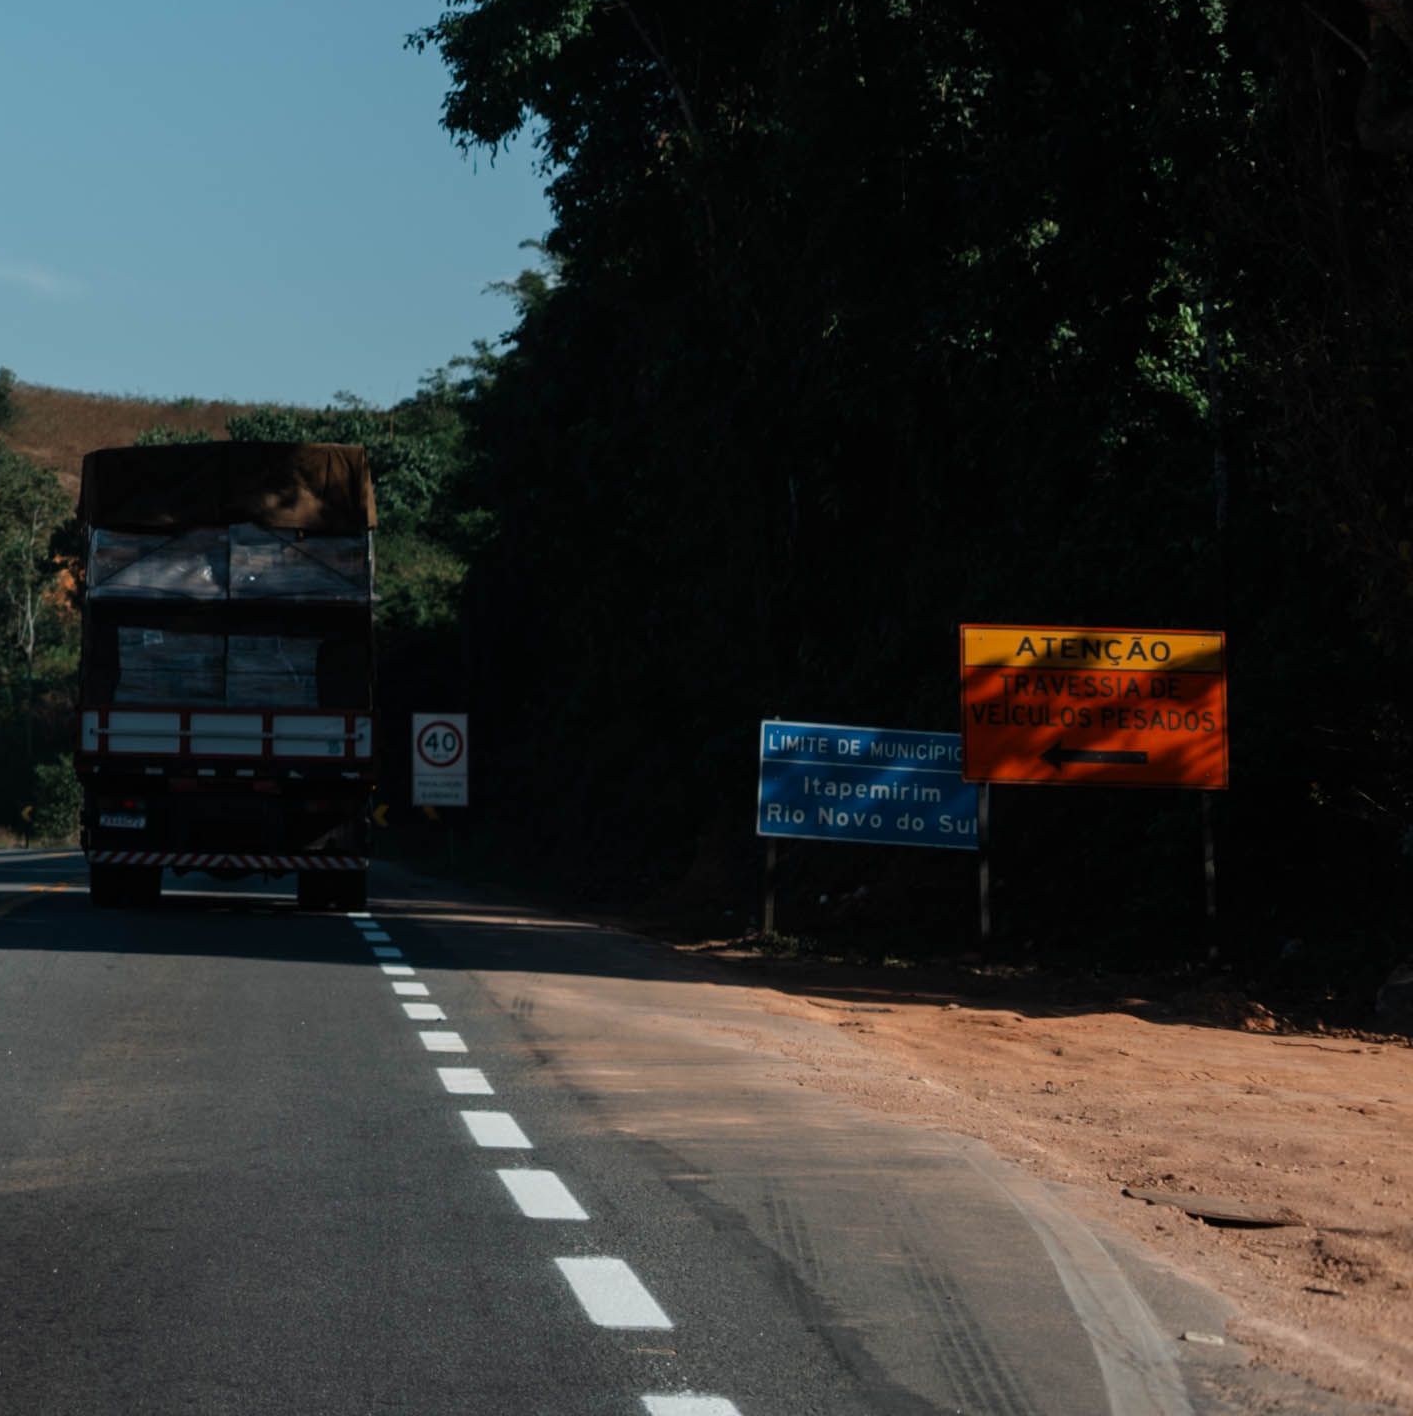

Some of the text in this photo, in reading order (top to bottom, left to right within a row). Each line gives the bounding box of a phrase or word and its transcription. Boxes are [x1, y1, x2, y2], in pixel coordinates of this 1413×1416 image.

[1015, 636, 1171, 666] ATENÇÃO
[1001, 674, 1182, 700] TRAVESSIA DE
[971, 700, 1216, 733] VEÍCULOS PESADOS
[425, 731, 456, 752] 40
[768, 733, 828, 754] LIMITE
[837, 738, 861, 756] DE
[804, 776, 941, 803] Itapemirim
[766, 803, 979, 835] Rio Novo do Sul
